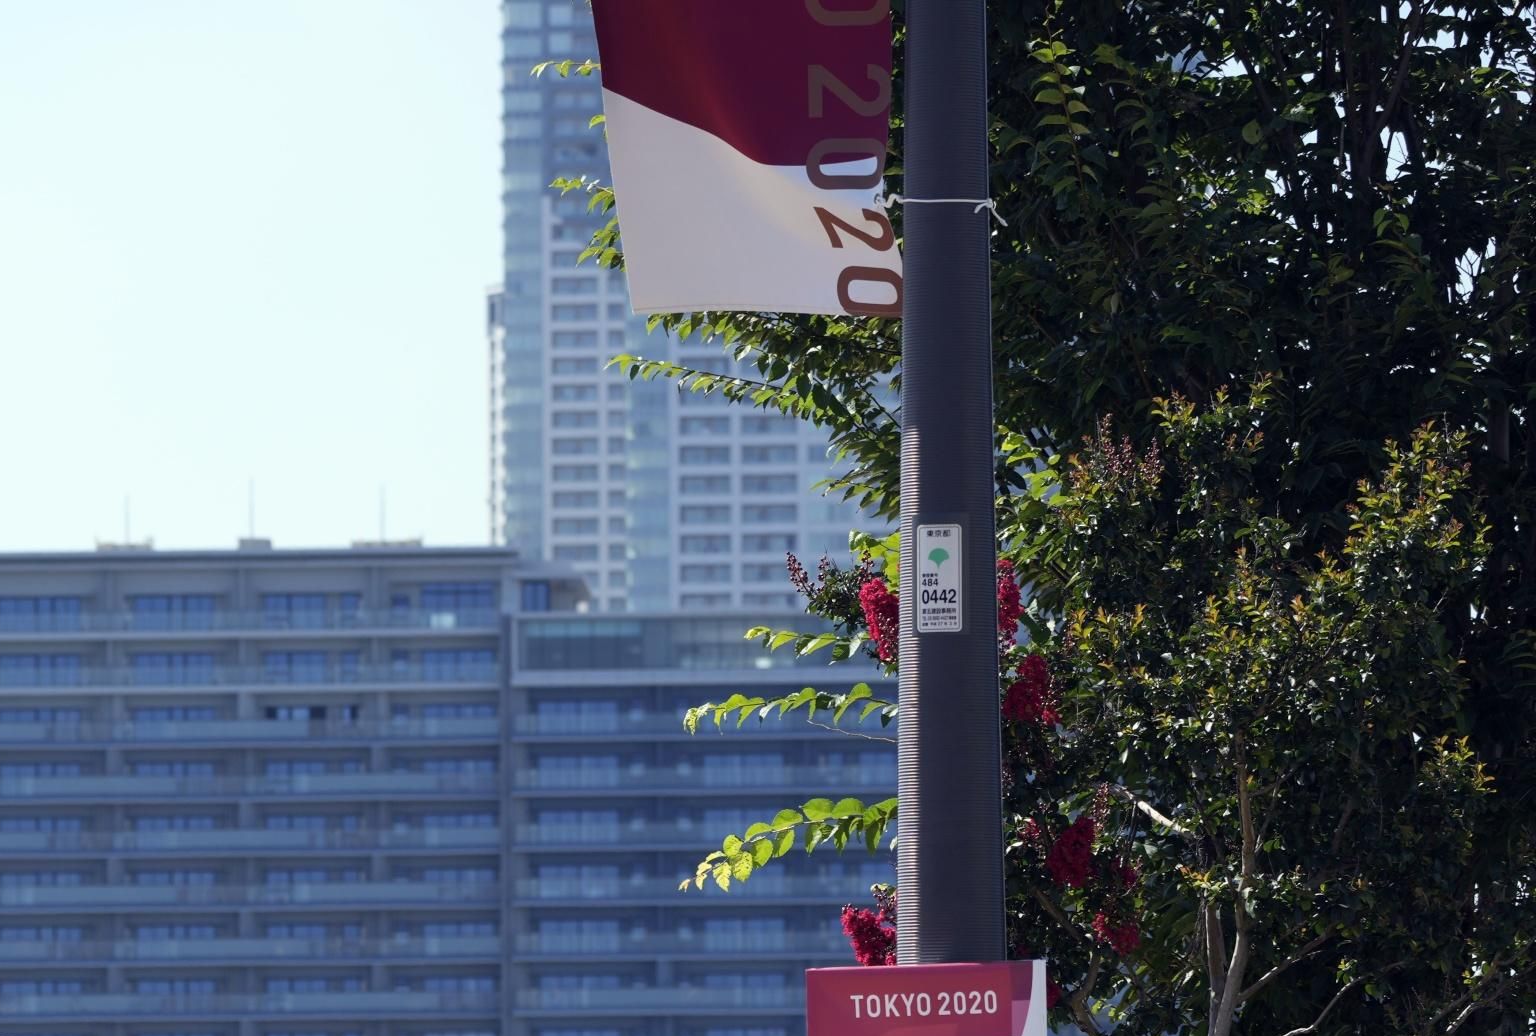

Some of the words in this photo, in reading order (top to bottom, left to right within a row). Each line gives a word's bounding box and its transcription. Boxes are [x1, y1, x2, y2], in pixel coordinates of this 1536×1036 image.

[806, 63, 904, 317] 2020
[922, 578, 939, 587] 484
[922, 588, 957, 605] 0442
[850, 992, 932, 1019] TOKYO
[937, 989, 999, 1017] 2020
